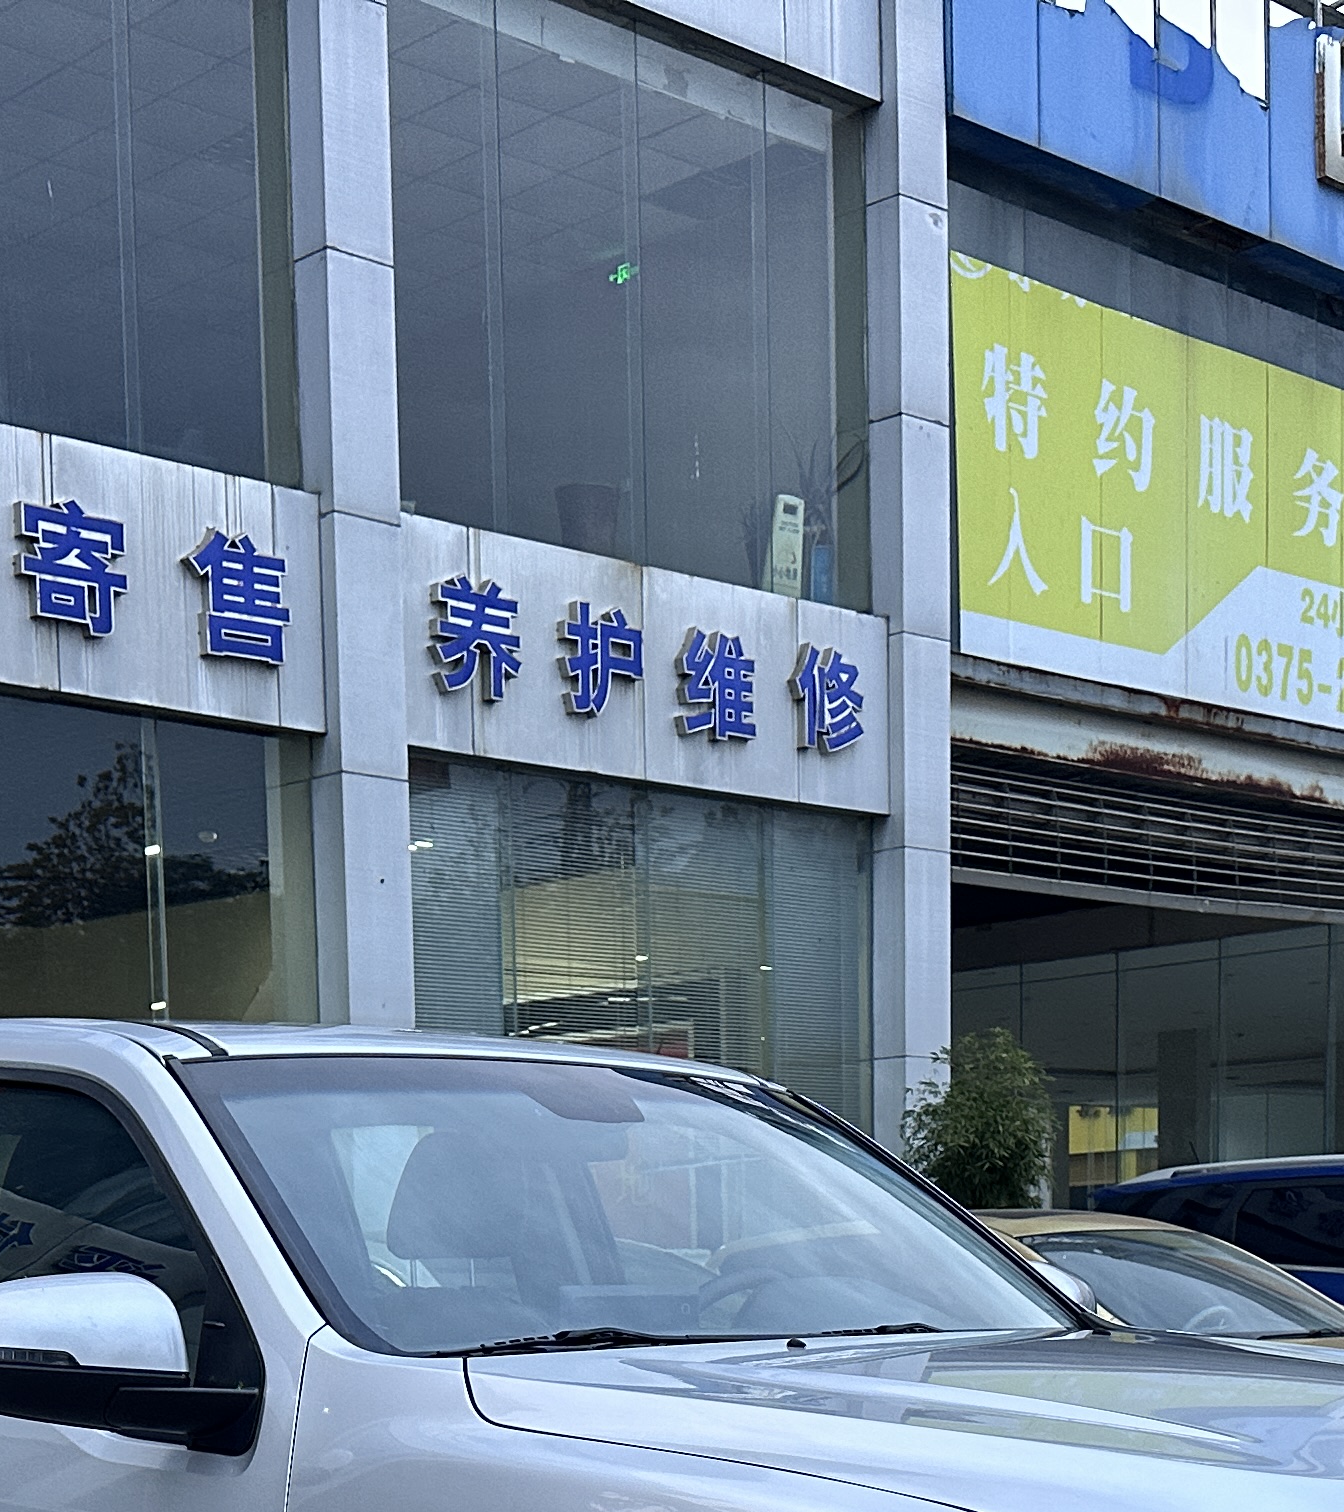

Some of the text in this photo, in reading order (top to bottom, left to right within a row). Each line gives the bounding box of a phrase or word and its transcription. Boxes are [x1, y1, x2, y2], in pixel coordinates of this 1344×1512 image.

[987, 487, 1133, 613] 入口
[427, 573, 866, 753] 养护维修
